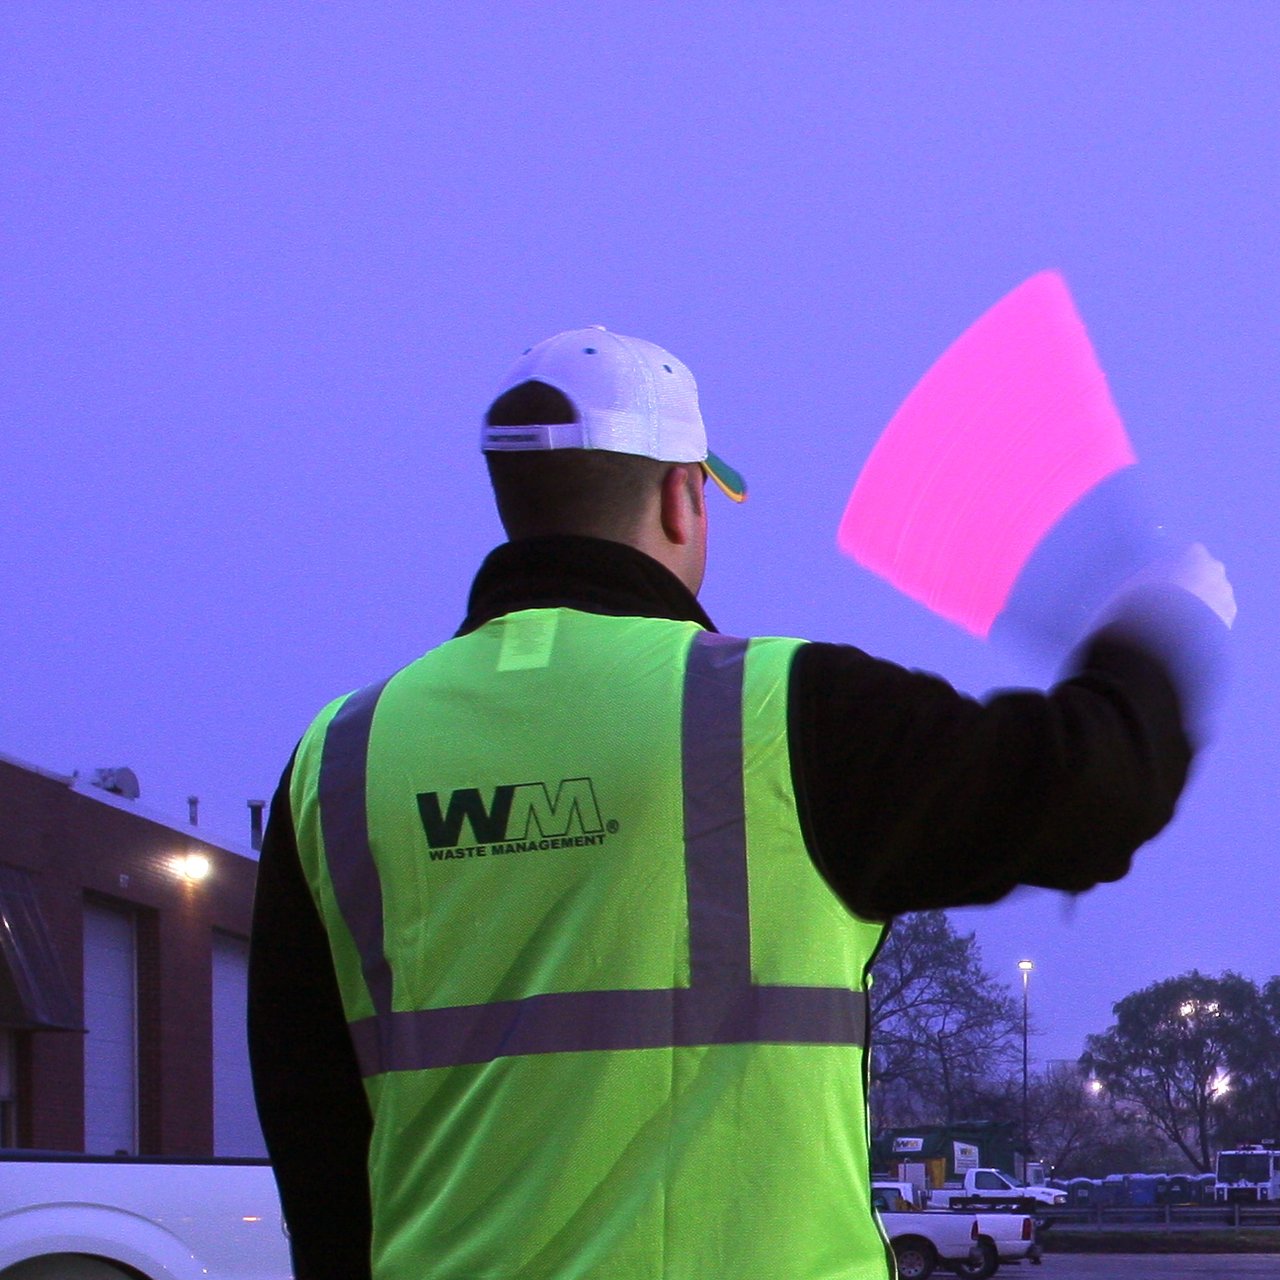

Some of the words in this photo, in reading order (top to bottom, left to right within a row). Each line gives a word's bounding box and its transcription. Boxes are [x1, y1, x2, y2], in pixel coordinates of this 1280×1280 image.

[416, 777, 604, 848] WM
[430, 846, 487, 861] WASTE
[491, 833, 605, 856] MANAGEMENT
